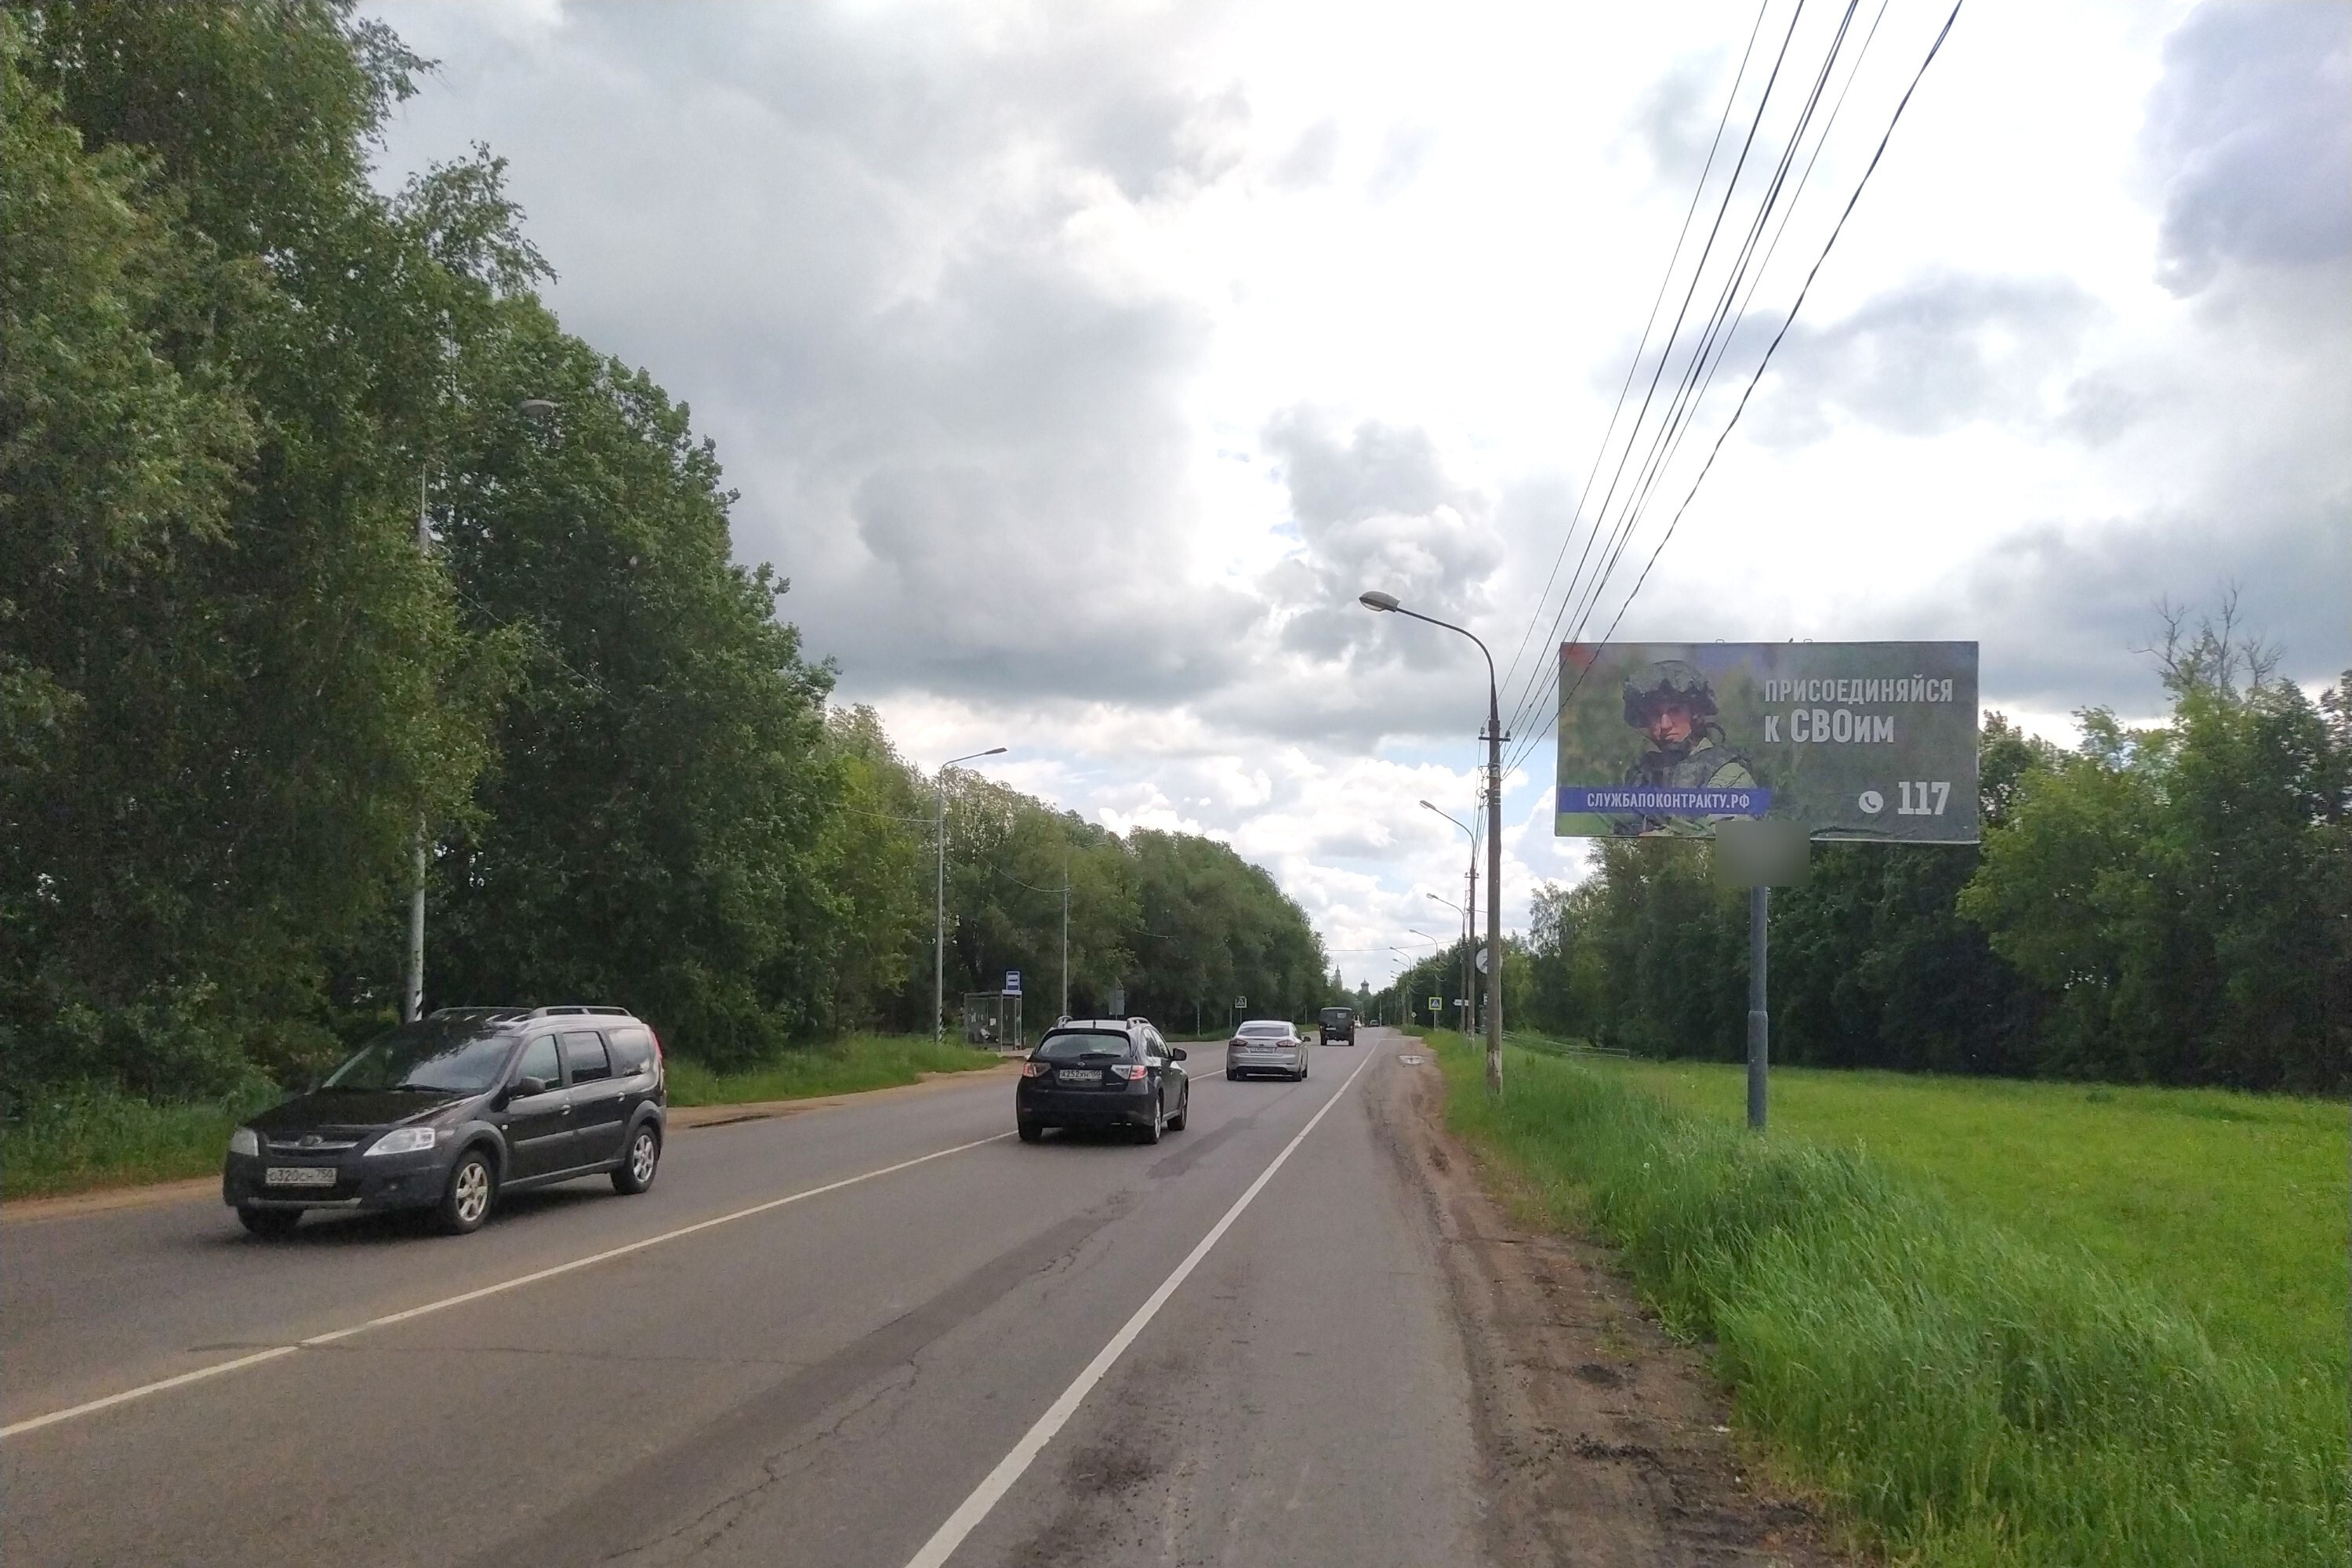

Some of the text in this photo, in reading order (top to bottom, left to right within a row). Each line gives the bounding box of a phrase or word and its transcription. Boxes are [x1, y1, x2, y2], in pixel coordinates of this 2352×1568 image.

[1764, 674, 1954, 705] ПРИСОЕДИНЯЙСЯ
[1587, 793, 1751, 809] СЛУЖБАПОКОНТРАКТУ.РФ
[1898, 782, 1951, 815] 117
